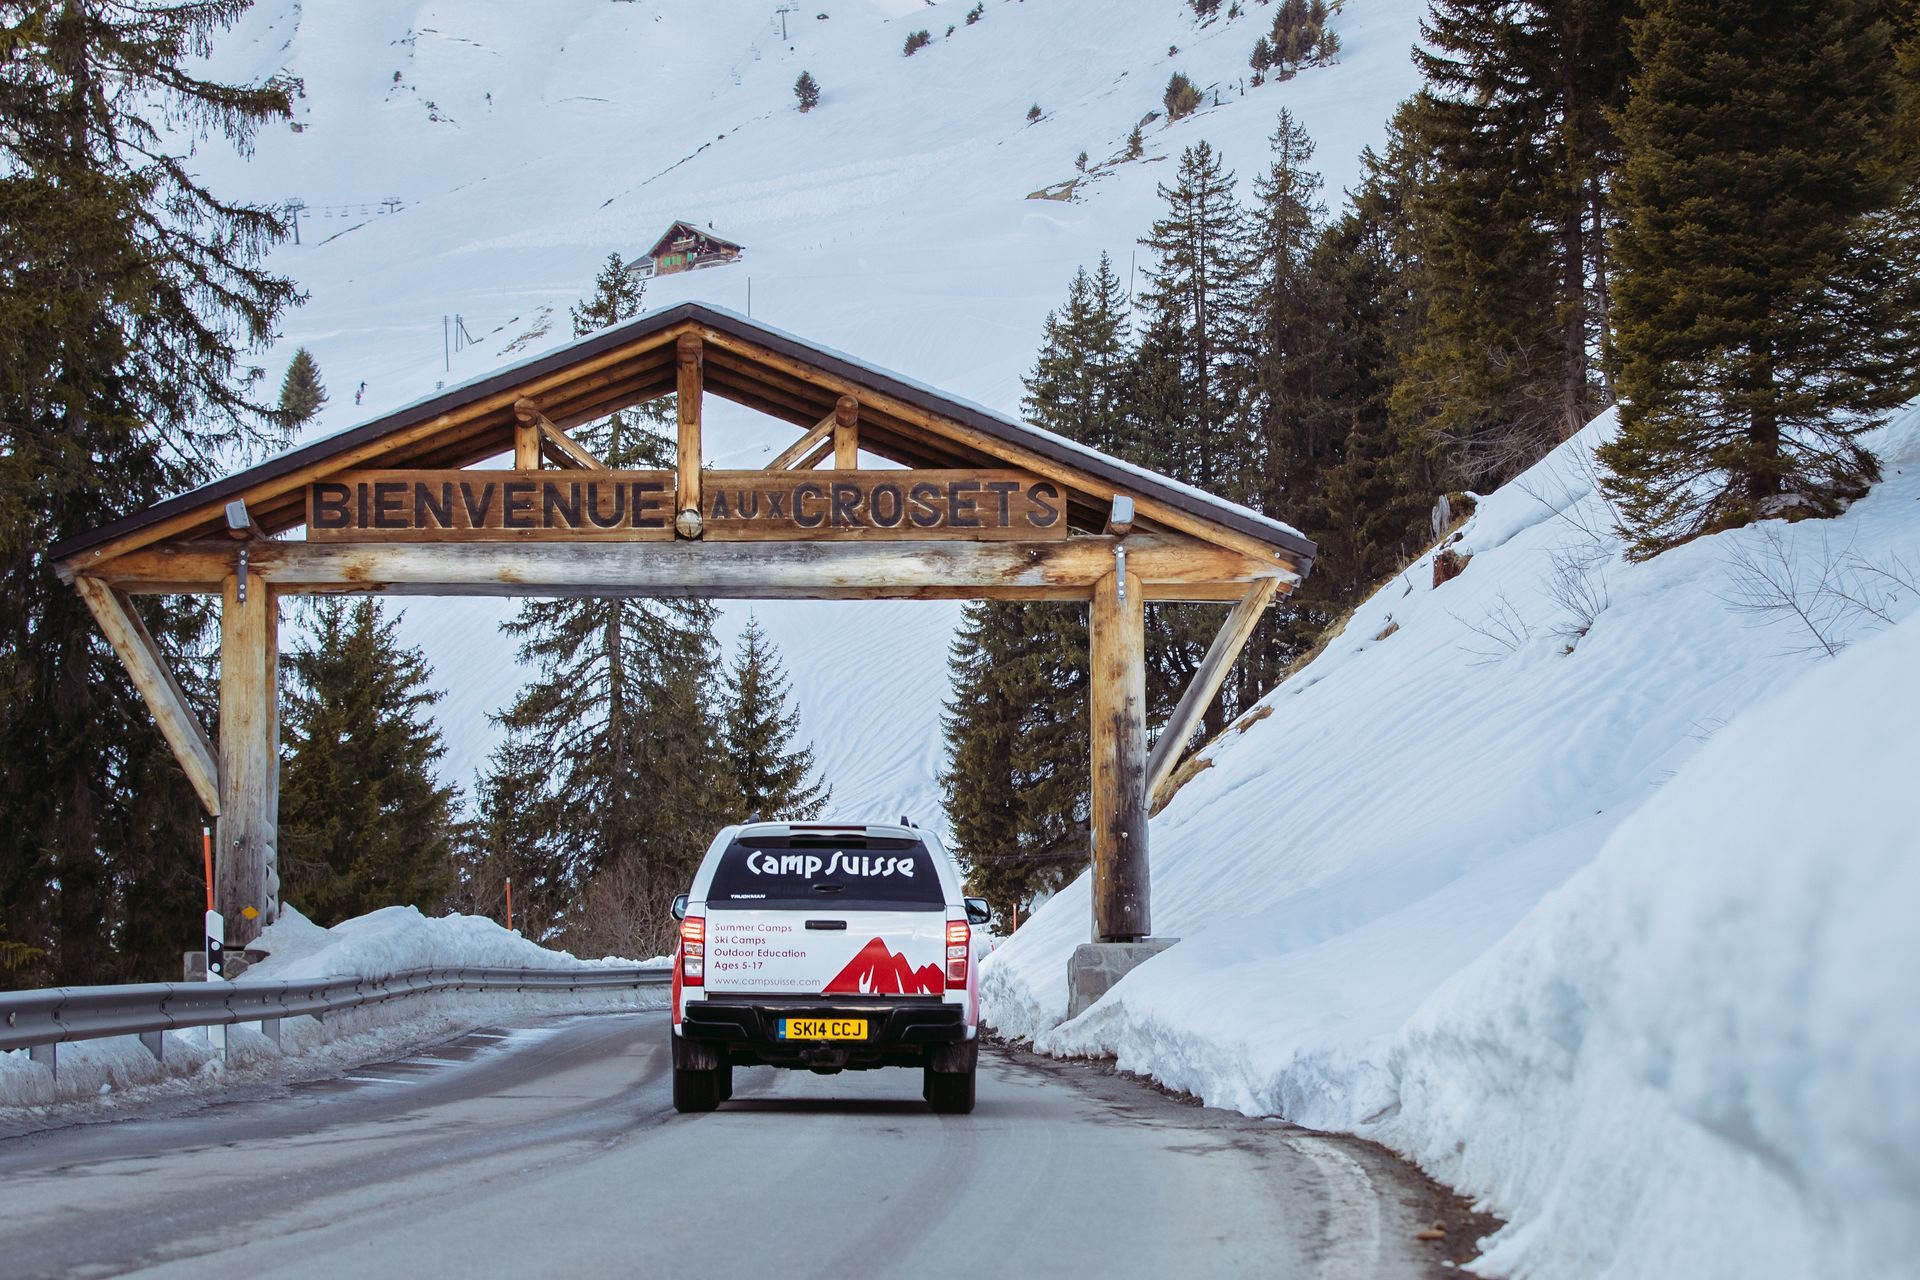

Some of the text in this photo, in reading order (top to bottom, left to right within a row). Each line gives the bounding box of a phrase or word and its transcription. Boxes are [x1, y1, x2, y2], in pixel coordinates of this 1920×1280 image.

[311, 481, 667, 530] BIENVENUE
[710, 481, 1060, 528] AUX CROSETS
[746, 850, 915, 879] Camp Suisse
[714, 923, 793, 934] Summer Camps
[714, 935, 767, 946] Ski Camps
[714, 948, 807, 959] Outdoor Education
[714, 961, 764, 972] Ages 5-17
[714, 977, 822, 988] www.campsuisse.com
[793, 1022, 862, 1037] SK14 CCJ
